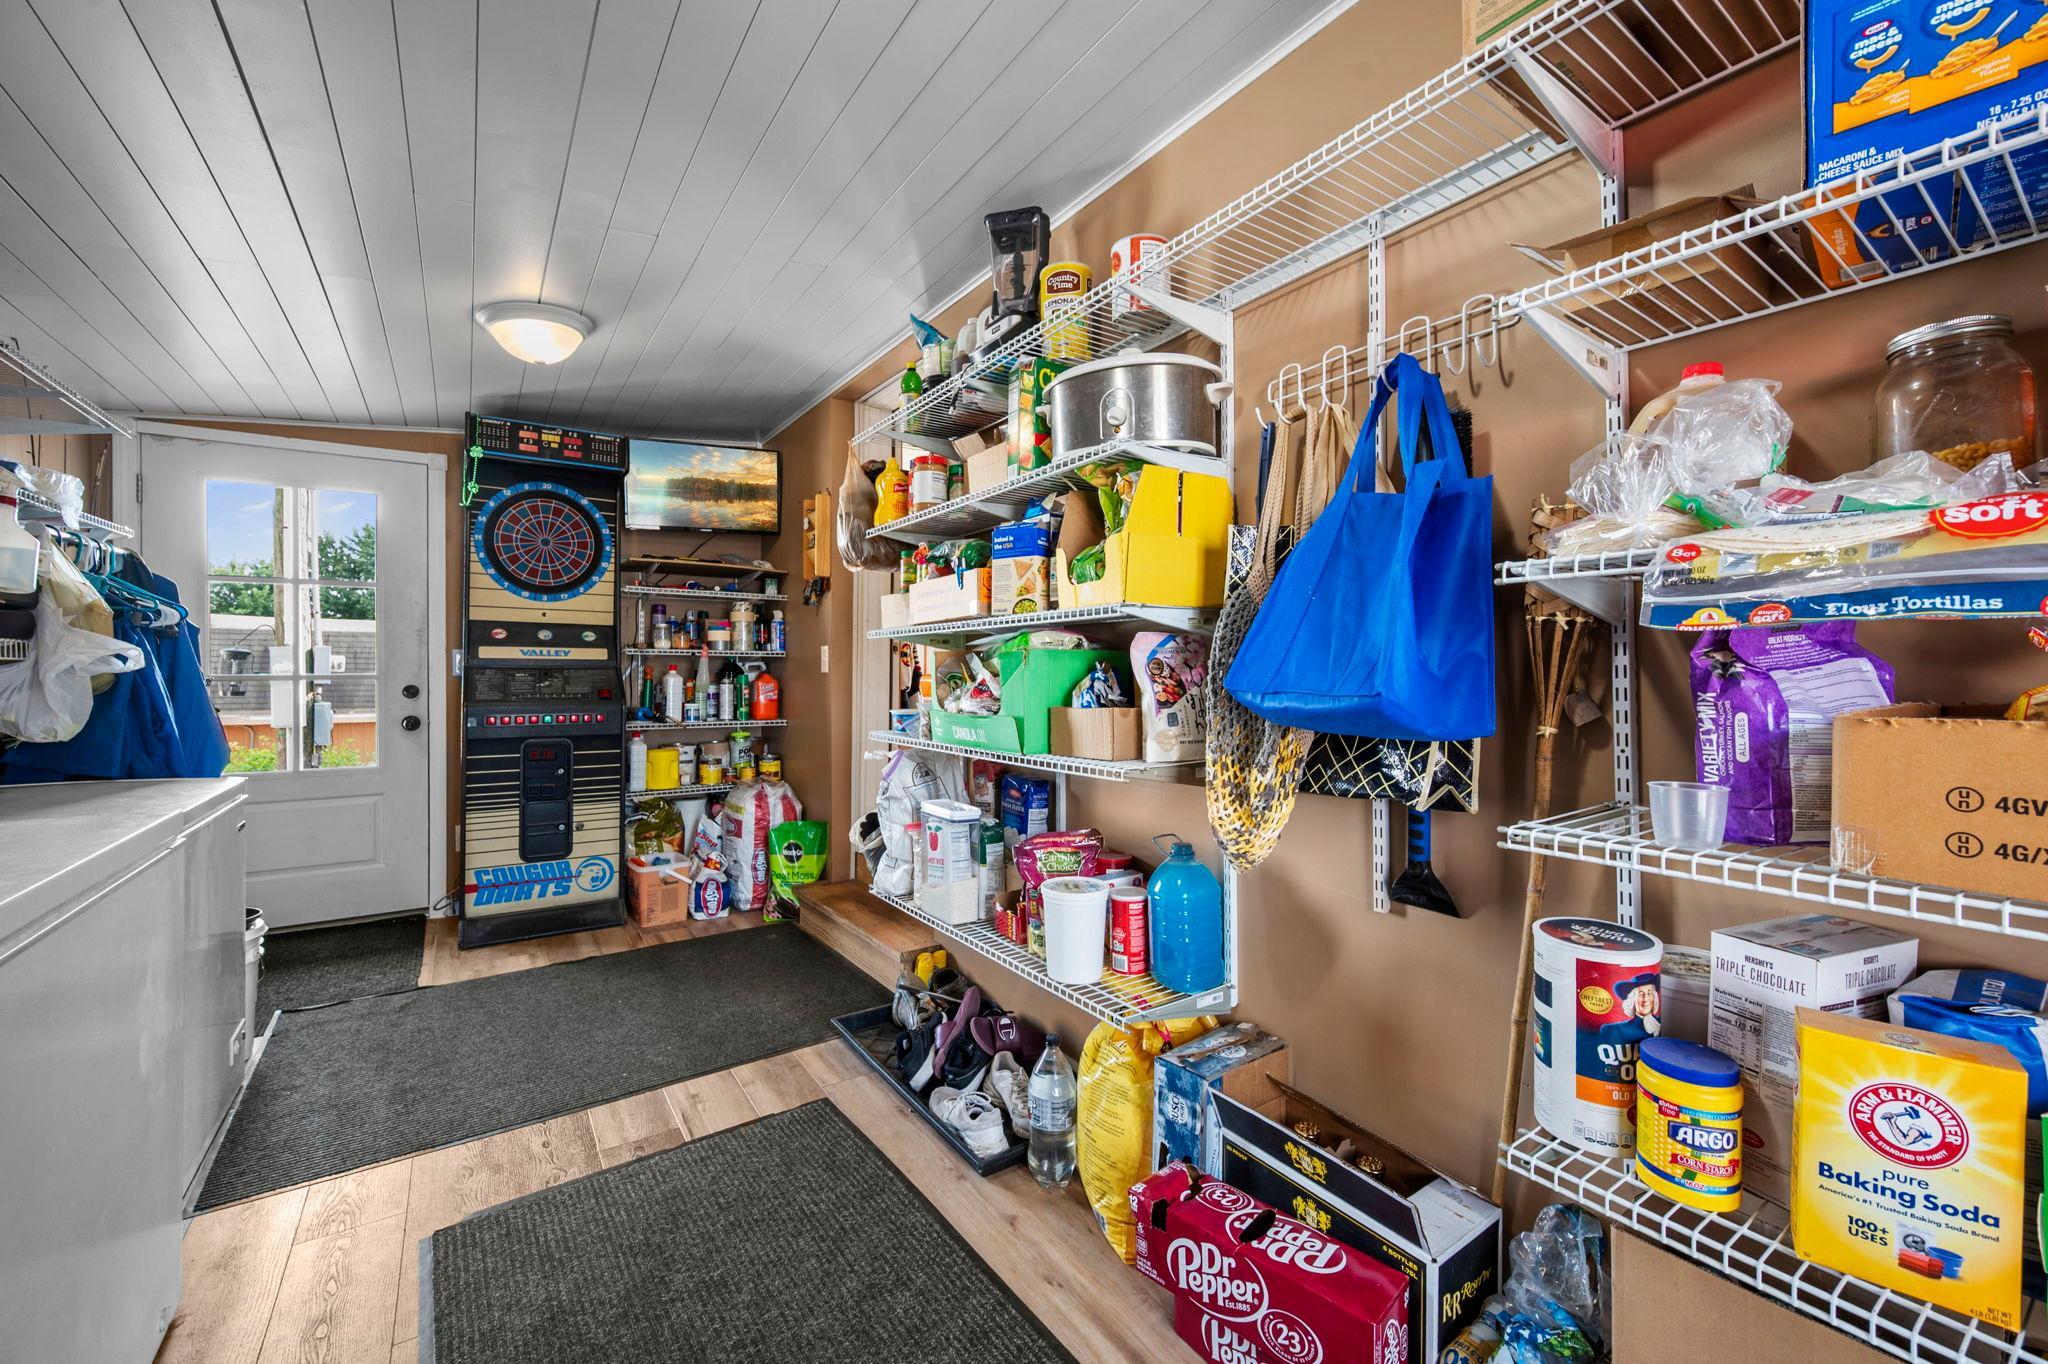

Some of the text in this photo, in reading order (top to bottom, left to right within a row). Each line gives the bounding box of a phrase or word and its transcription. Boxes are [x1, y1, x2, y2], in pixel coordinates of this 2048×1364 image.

[1971, 55, 2011, 74] original
[1979, 63, 2011, 78] flavor
[1989, 105, 2001, 116] 18
[2010, 95, 2033, 109] 7.25
[1818, 147, 1905, 181] CHEESE SAUCE MIX
[1819, 147, 1877, 172] MACARONI &
[1048, 274, 1078, 286] Country
[1053, 282, 1073, 290] Time
[1943, 498, 2043, 523] soft
[1671, 548, 1697, 558] 8ct
[1825, 595, 2003, 616] Flour Tortillas
[519, 649, 571, 657] VALLEY
[953, 726, 976, 741] CANOLA
[1696, 692, 1719, 782] VARIETY MIX
[1739, 741, 1747, 756] ALL
[1995, 796, 2048, 817] 4GV
[1043, 852, 1077, 864] Earthly
[1047, 862, 1079, 871] Choice
[474, 861, 573, 887] COUGAR
[771, 871, 815, 880] Peat Moss
[473, 879, 573, 906] DARTS
[1571, 924, 1634, 944] QUAKER
[1589, 926, 1625, 937] OATS
[1744, 955, 1774, 970] HERSHEY'S
[1863, 955, 1879, 965] HERSHEY'S
[1715, 956, 1806, 996] TRIPLE CHOCOLATE
[1845, 969, 1864, 990] TRIPLE
[1866, 964, 1896, 986] CHOCOLATE
[1715, 987, 1742, 1001] Nutrition
[1745, 997, 1762, 1008] Facts
[1612, 1091, 1630, 1100] OLD
[1171, 1092, 1183, 1124] BUSCH
[1662, 1106, 1676, 1116] free
[1856, 1088, 1963, 1146] ARM & HAMMER
[1676, 1127, 1734, 1149] ARGO
[1867, 1131, 1878, 1142] THE
[1877, 1139, 1916, 1161] STANDARD
[1926, 1150, 1949, 1162] PURITY
[1677, 1155, 1733, 1175] CORN STARCH
[1883, 1169, 1930, 1190] pure
[1819, 1161, 2000, 1228] Baking Soda
[1819, 1184, 2000, 1243] America's #1 Trusted Baking Soda Brand
[1847, 1215, 1890, 1236] 100+
[1234, 1216, 1346, 1274] Peppr
[1848, 1226, 1888, 1247] USES
[1201, 1242, 1236, 1278] Dr
[1251, 1236, 1300, 1264] Dr
[1388, 1249, 1419, 1271] BOTTLES
[1167, 1238, 1260, 1308] Pepper
[1401, 1265, 1419, 1281] 1.75L
[1987, 1307, 2012, 1319] NET WT
[1276, 1323, 1301, 1354] 23
